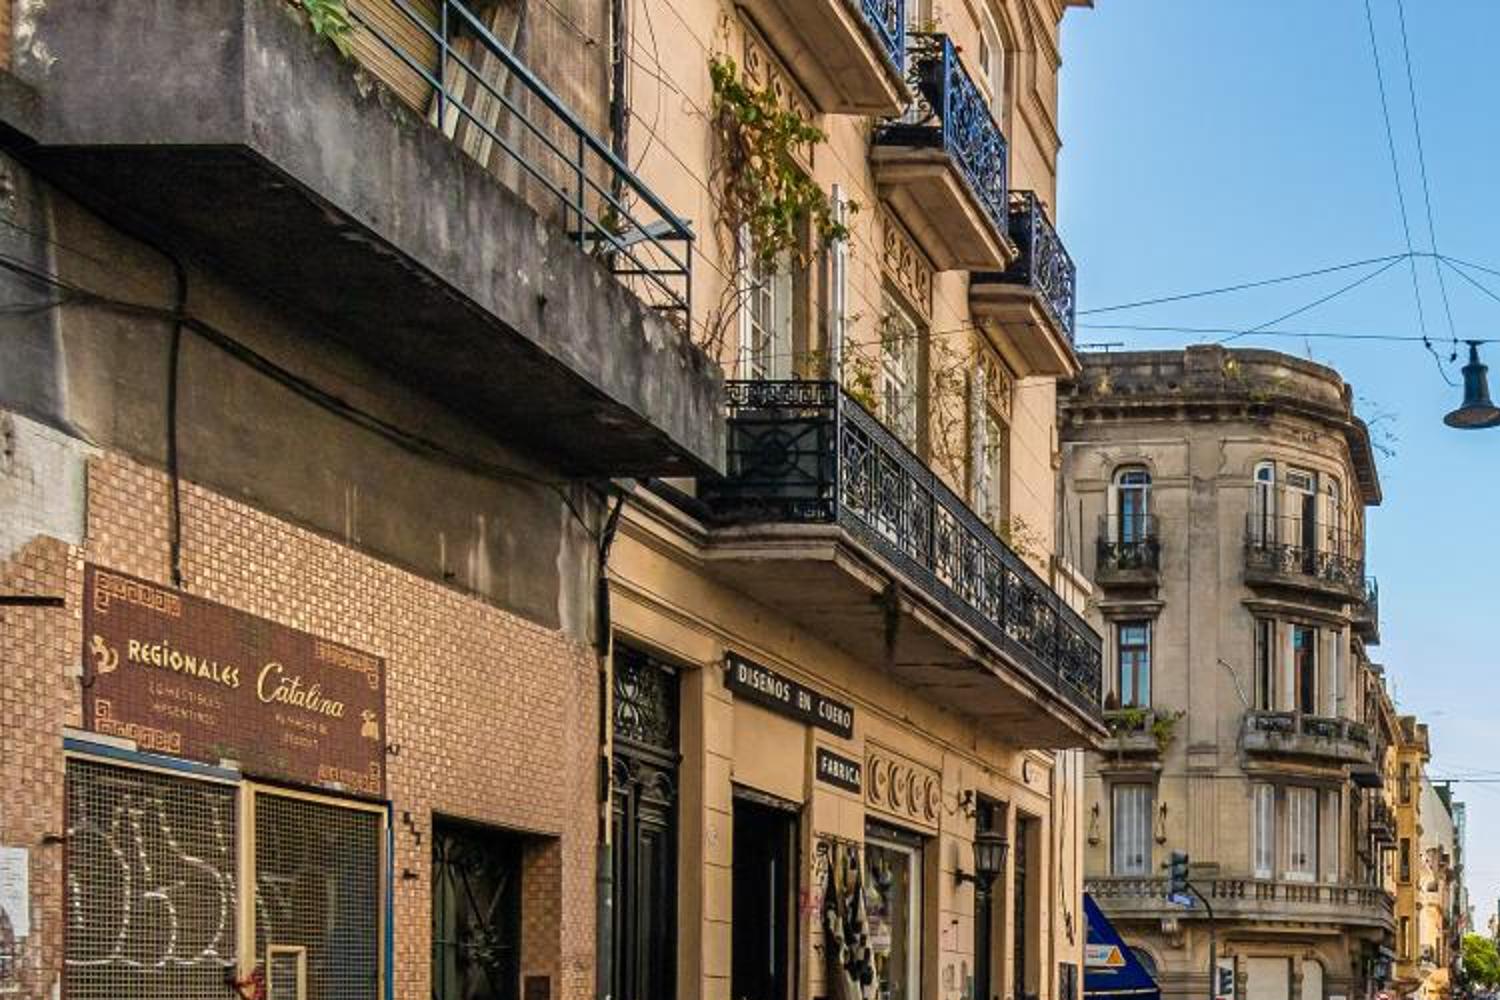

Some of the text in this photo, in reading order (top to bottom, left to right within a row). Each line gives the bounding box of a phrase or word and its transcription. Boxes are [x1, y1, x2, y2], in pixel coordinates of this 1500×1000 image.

[257, 662, 345, 718] Catalina
[738, 663, 851, 729] DISEÑOS EN CUERO
[821, 756, 860, 785] FABRICA
